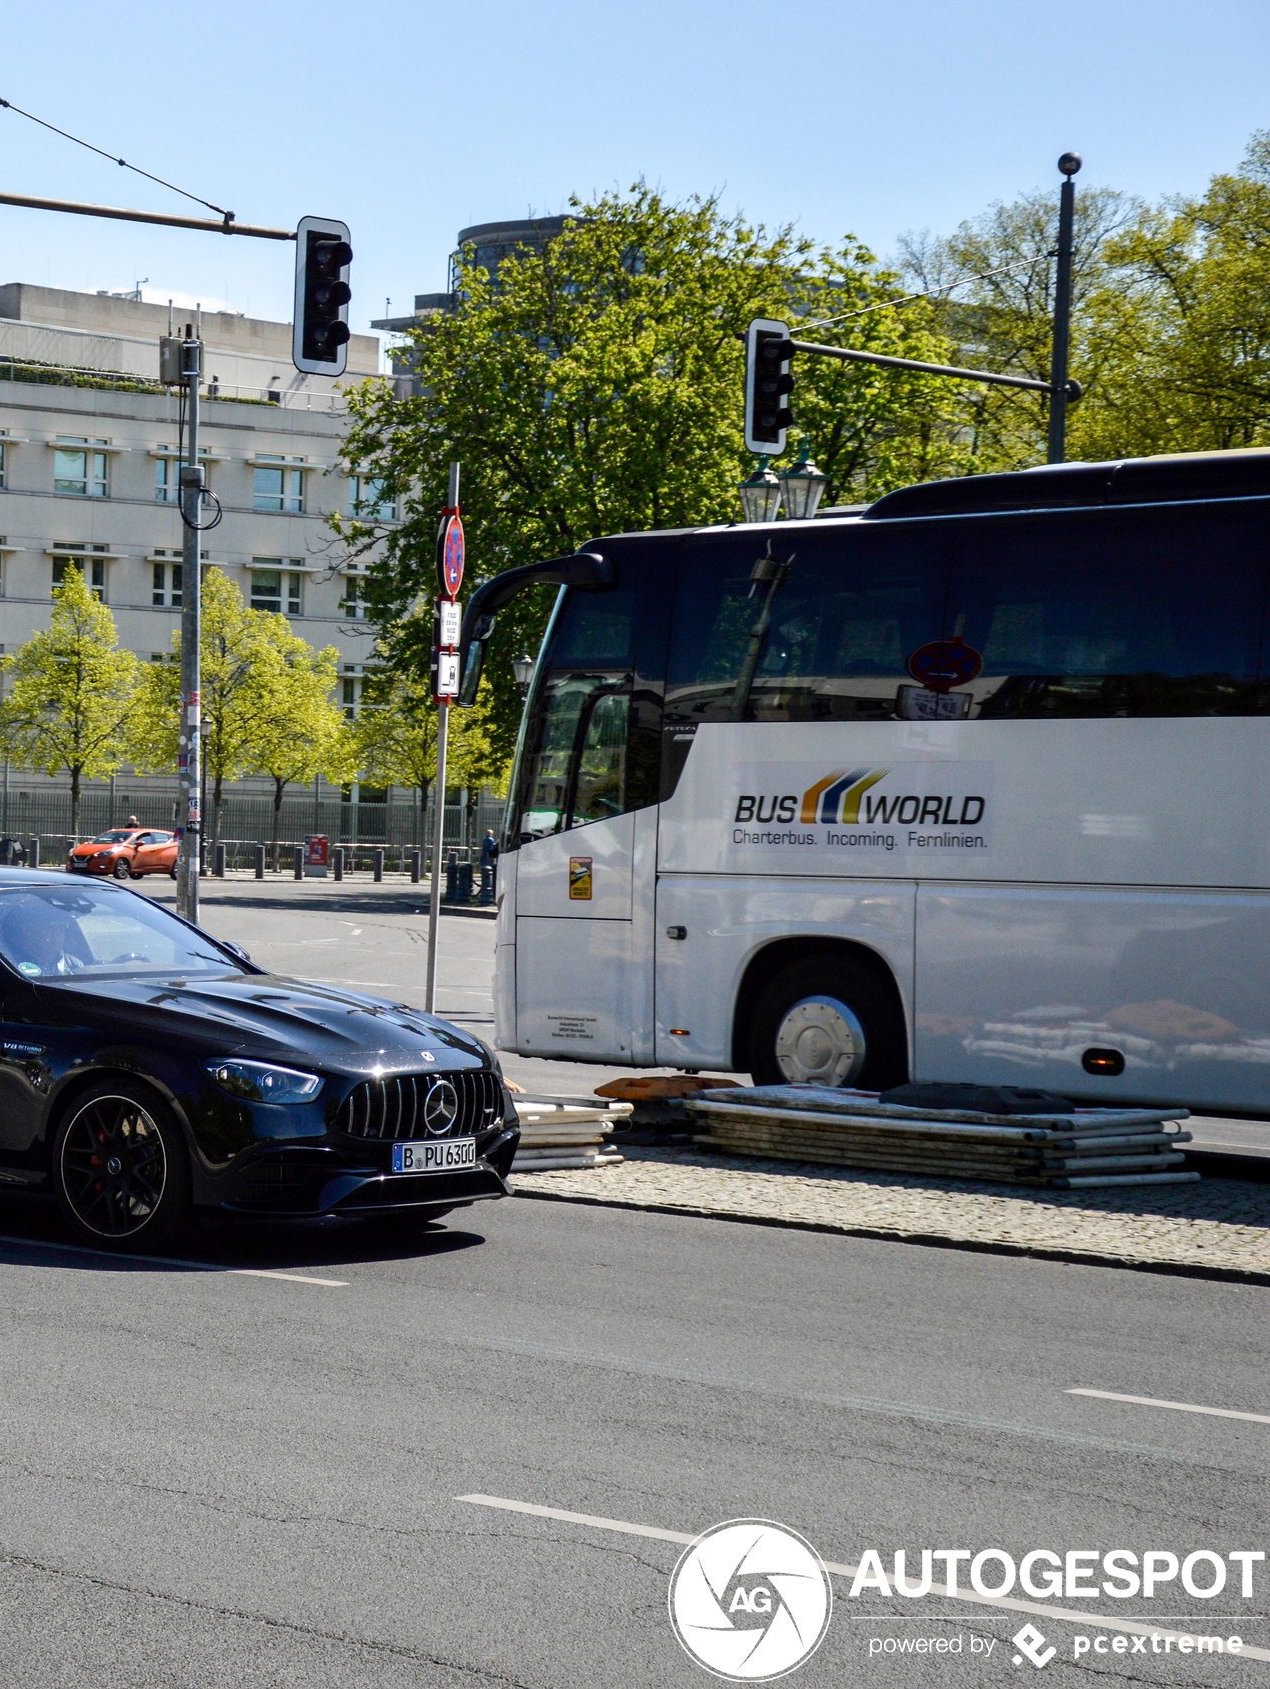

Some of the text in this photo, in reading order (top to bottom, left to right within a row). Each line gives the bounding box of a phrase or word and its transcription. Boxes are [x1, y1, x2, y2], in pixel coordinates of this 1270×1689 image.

[734, 795, 986, 825] BUS WORLD
[733, 829, 988, 850] Charterbus. Incoming. Fernlinien.
[18, 1044, 42, 1052] BITURBO
[404, 1143, 475, 1168] B PU 6300
